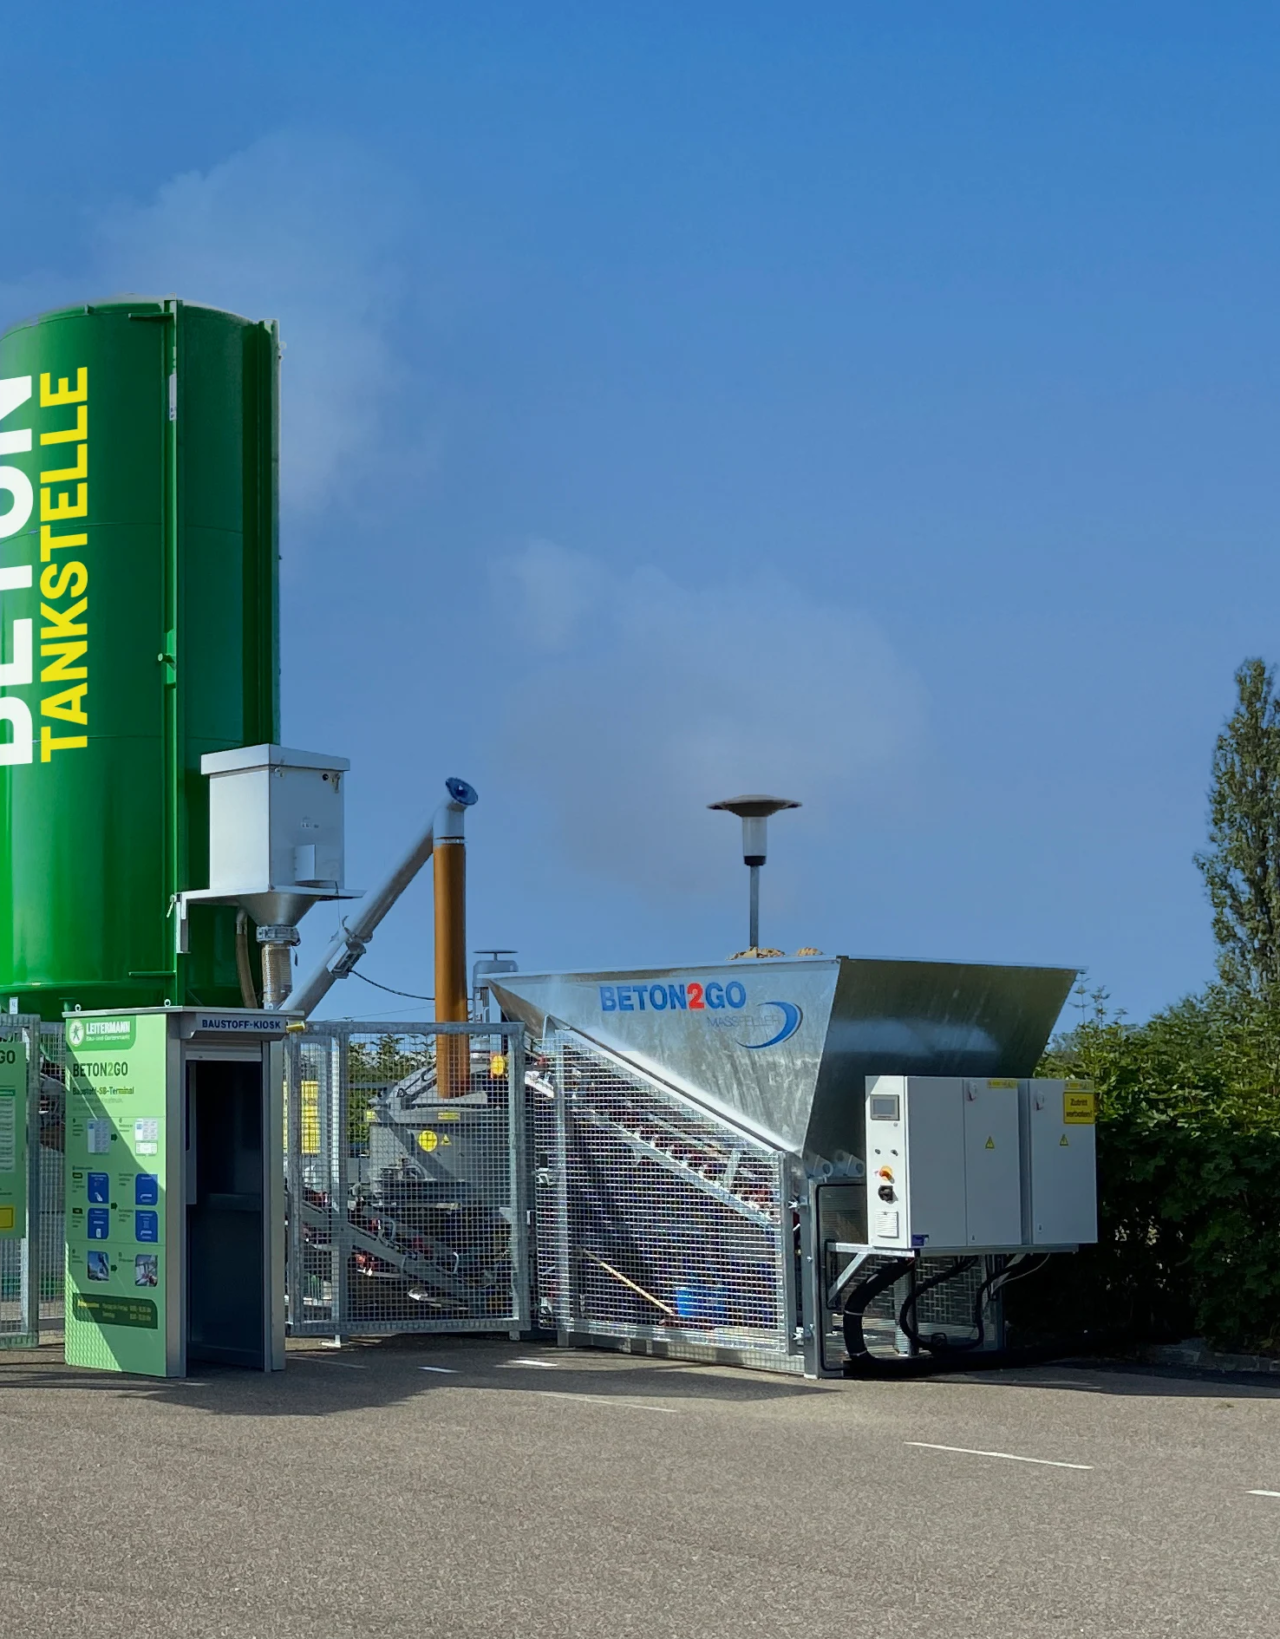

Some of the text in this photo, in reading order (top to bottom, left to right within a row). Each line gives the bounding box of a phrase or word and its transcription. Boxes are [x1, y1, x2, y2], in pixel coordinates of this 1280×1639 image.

[39, 366, 88, 763] TANKSTELLE
[599, 981, 747, 1012] BETON2GO
[85, 1020, 131, 1035] LEITERMANN
[201, 1019, 281, 1030] BAUSTOFF-KIOSK
[72, 1061, 129, 1078] BETON2GO
